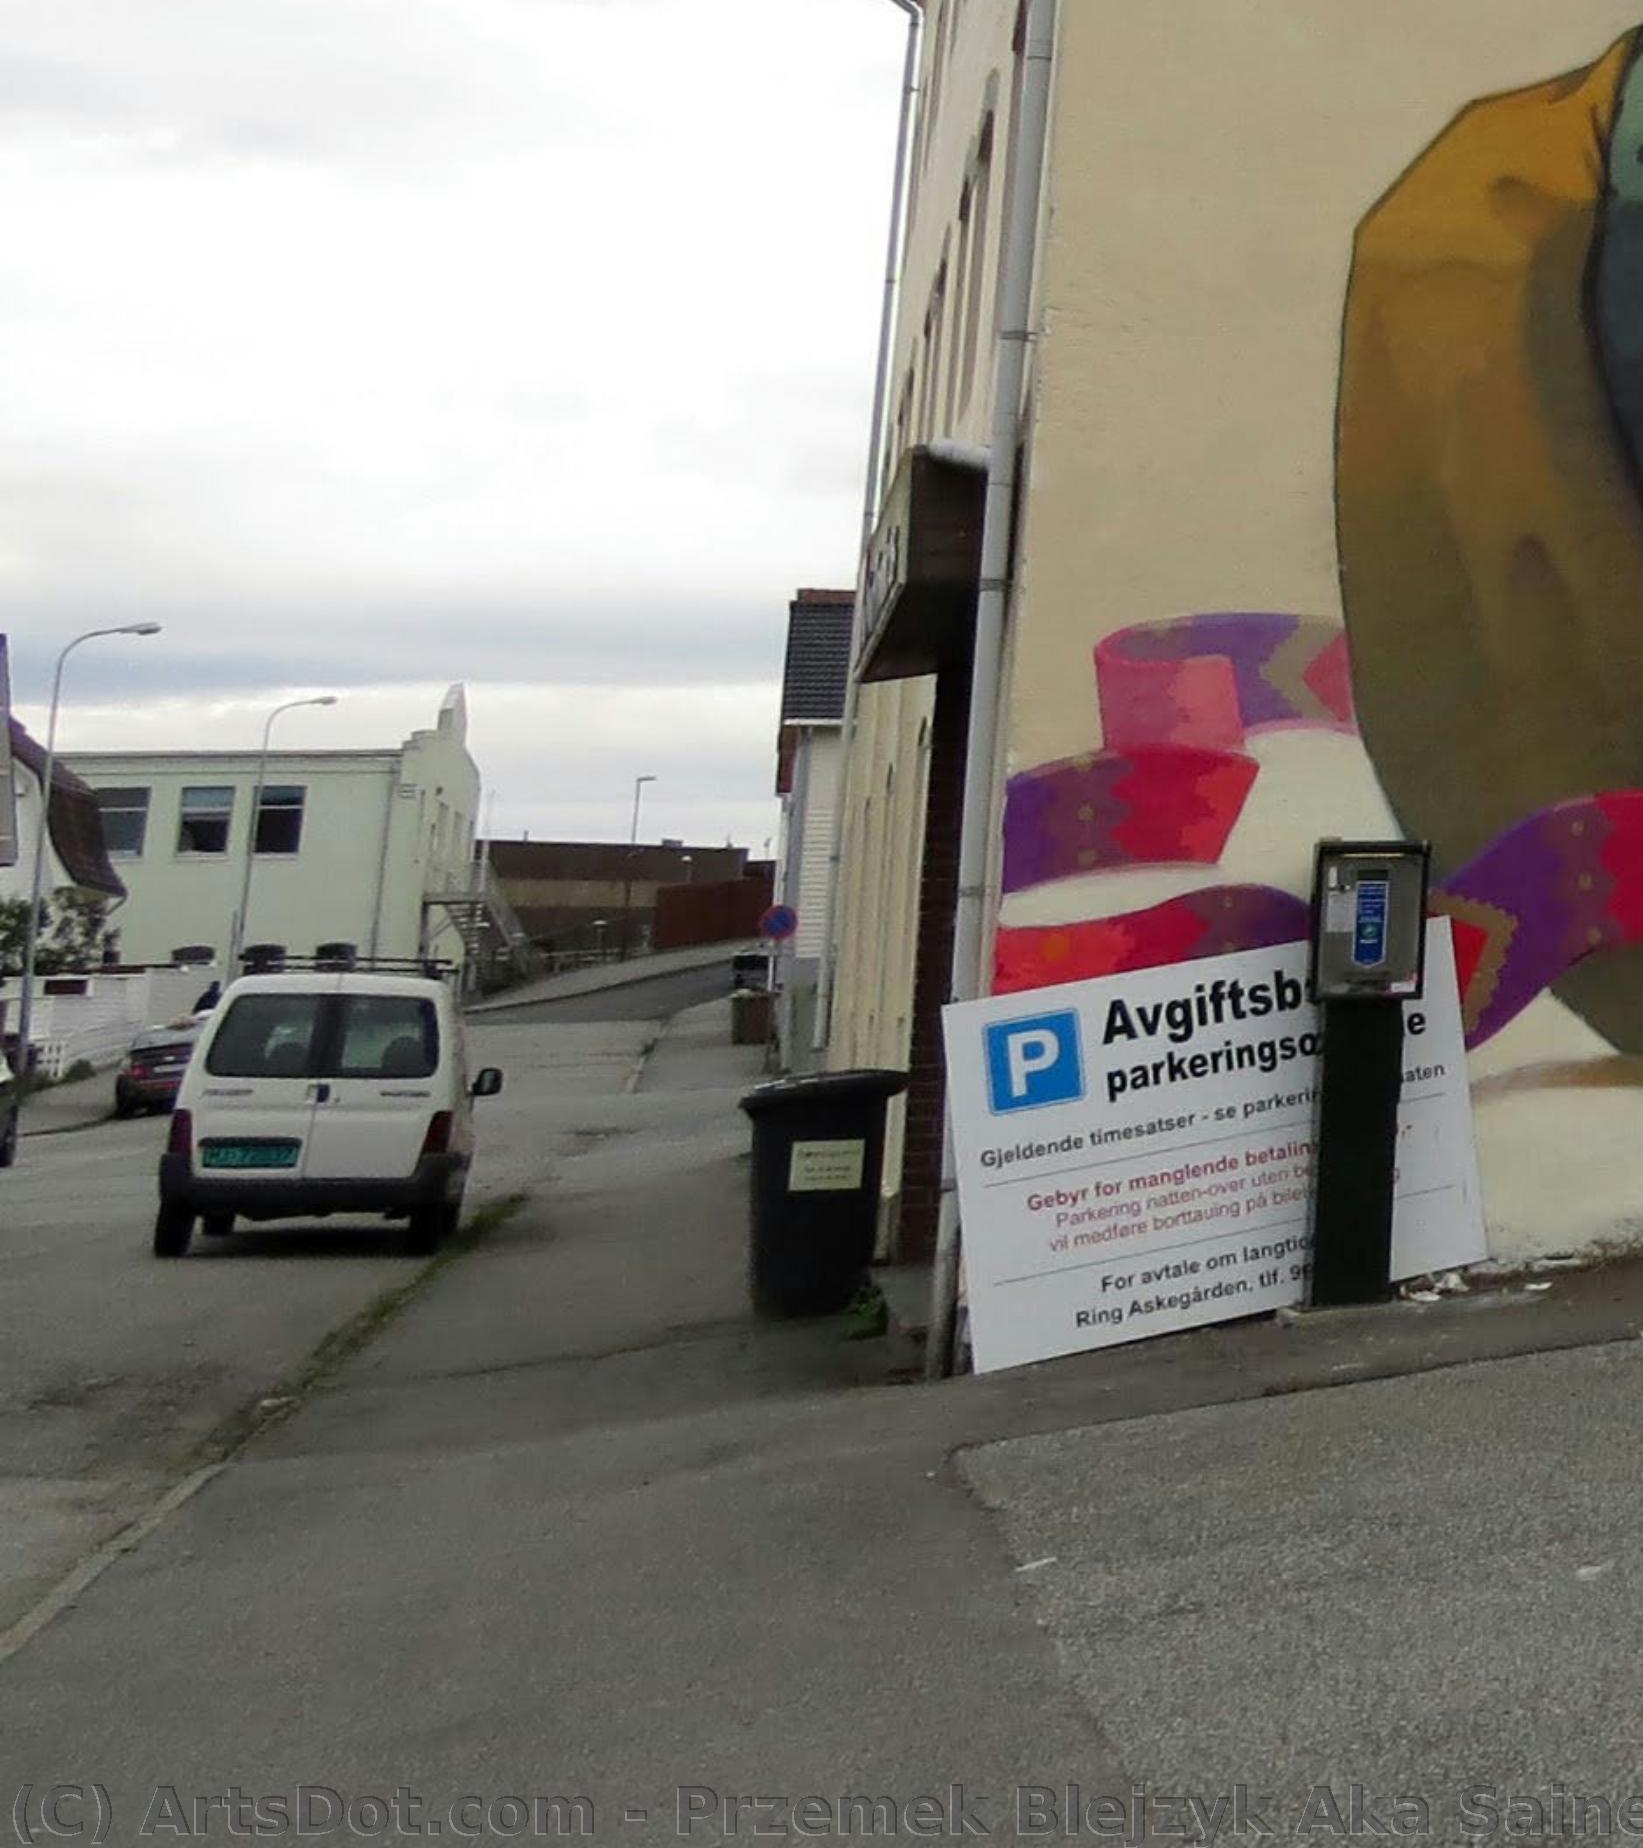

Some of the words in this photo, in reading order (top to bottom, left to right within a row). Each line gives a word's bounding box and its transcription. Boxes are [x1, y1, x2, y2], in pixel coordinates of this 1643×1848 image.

[1102, 969, 1312, 1045] Avgiftsb
[1007, 1028, 1060, 1098] P
[981, 1136, 1084, 1168] Gjeldende
[1090, 1113, 1195, 1146] timesatser
[1214, 1105, 1236, 1122] se
[1027, 1187, 1088, 1212] Gebyr
[1095, 1180, 1122, 1198] for
[1129, 1154, 1239, 1188] manglende
[1056, 1197, 1141, 1228] Parkering
[1251, 1167, 1289, 1187] uten
[1050, 1234, 1069, 1252] vil
[1074, 1219, 1148, 1246] medføre
[1246, 1189, 1267, 1213] på
[1101, 1272, 1133, 1292] For
[1141, 1255, 1201, 1284] avtale
[1206, 1251, 1238, 1270] om
[1076, 1305, 1123, 1328] Ring
